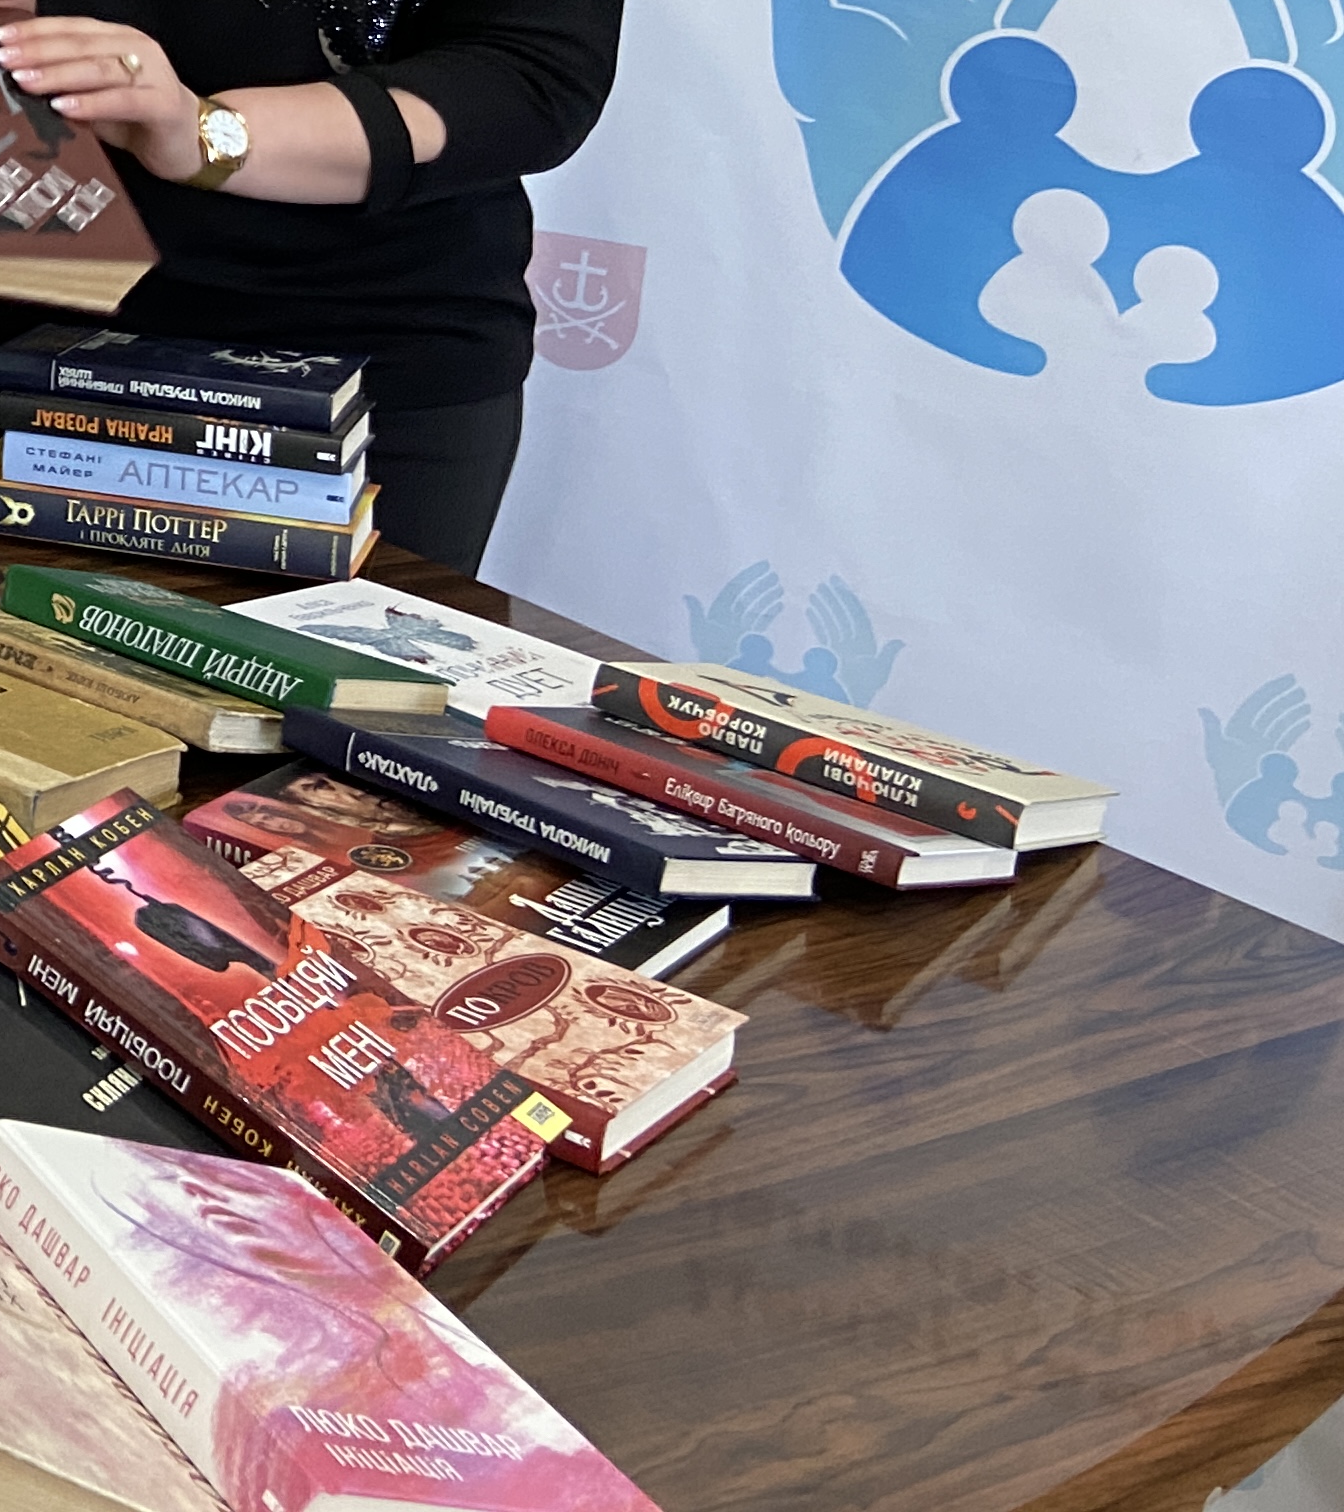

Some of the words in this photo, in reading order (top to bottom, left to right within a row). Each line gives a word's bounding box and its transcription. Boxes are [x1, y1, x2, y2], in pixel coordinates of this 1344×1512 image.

[130, 379, 198, 402] ТРУБЛАЇНІ
[198, 388, 261, 410] МИКОЛА
[30, 407, 101, 433] РОЗВАГ
[195, 423, 272, 455] КІНГ
[24, 446, 103, 464] СТЕФАНІ
[117, 459, 300, 504] АПТЕКАР
[132, 506, 228, 544] ПОТТЕР
[76, 602, 205, 669] ПЛАТОНОВ
[198, 646, 305, 706] АНДРІЙ
[666, 694, 767, 739] КОРОБЧУК
[698, 722, 763, 755] ПАВЛО
[524, 727, 578, 762] ОЛЕКСА
[576, 748, 620, 775] ДОНІЧ
[823, 748, 923, 792] КЛАПАНИ
[823, 763, 918, 808] КЛЮЧОВІ
[459, 789, 538, 837] ТРУБЛАЇНІ
[6, 846, 87, 899] ХАРЛАН
[89, 806, 154, 851] КОБЕН
[206, 836, 252, 863] ТАРАС
[539, 820, 612, 865] МИКОЛА
[25, 952, 80, 1006] МЕНІ
[210, 943, 359, 1061] ПООБІЦЯЙ
[83, 996, 192, 1096] ПООБІЦЯЙ
[307, 1019, 398, 1091] МЕНІ
[201, 1094, 273, 1159] КОБЕН
[384, 1130, 462, 1196] HARLAN
[460, 1077, 524, 1134] COBEN
[18, 1204, 94, 1290] ДАШВАР
[99, 1296, 200, 1419] ІНІЦІАЦІЯ
[287, 1403, 392, 1444] ЛЮКО
[387, 1418, 525, 1463] ДАШВАР
